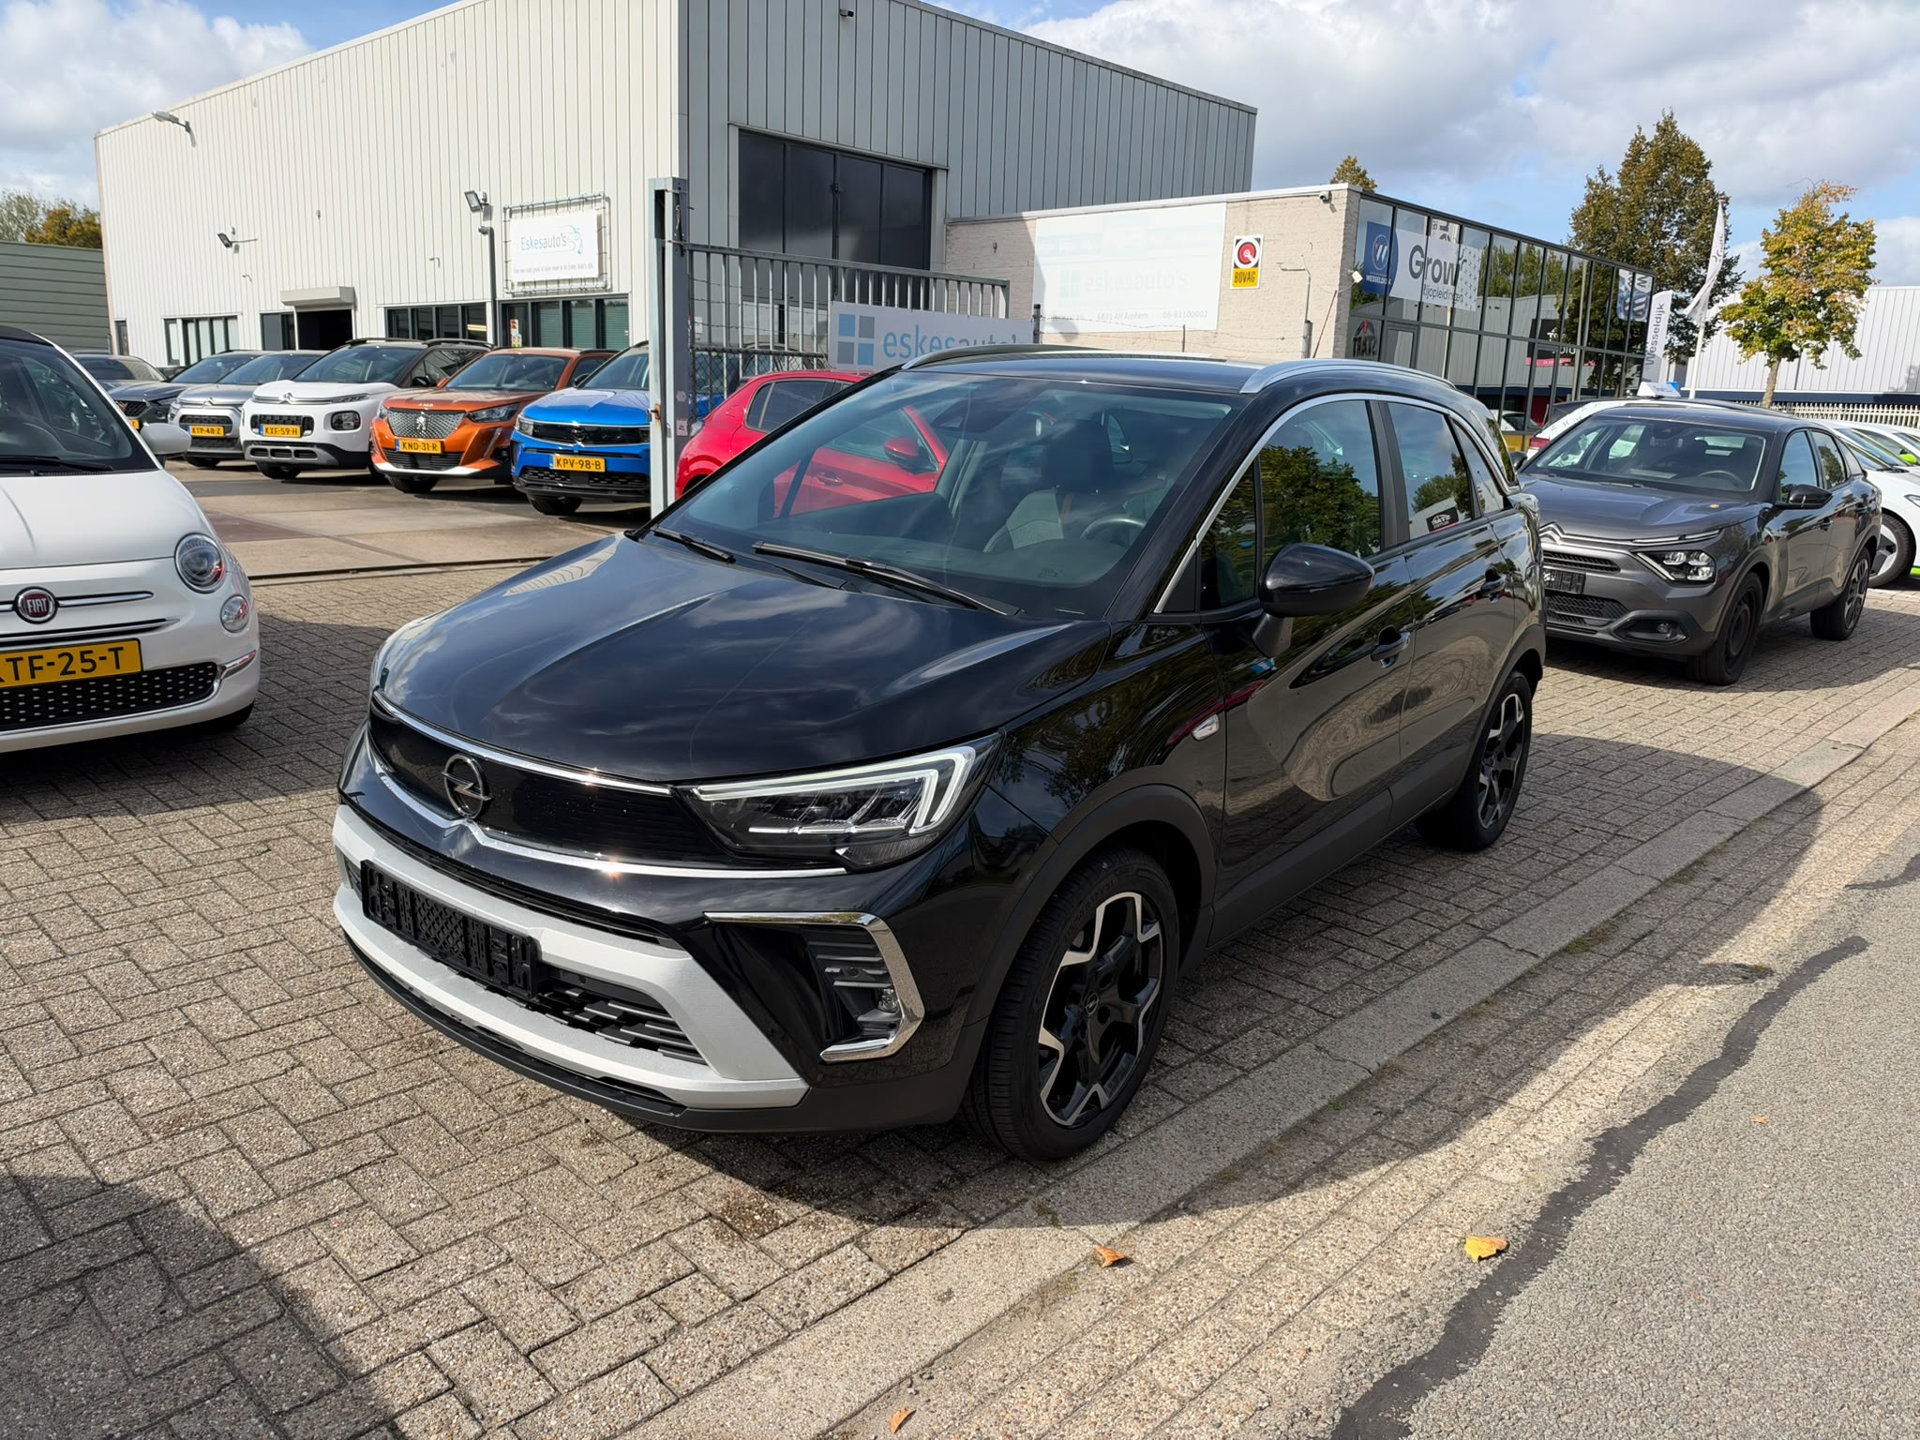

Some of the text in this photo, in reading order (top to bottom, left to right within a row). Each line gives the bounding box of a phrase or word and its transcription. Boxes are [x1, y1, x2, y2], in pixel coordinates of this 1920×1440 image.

[520, 232, 567, 251] Eskesauto's
[1408, 244, 1458, 287] Grow
[1234, 270, 1256, 284] BOVAG
[1365, 274, 1392, 285] WESSELDIK
[265, 427, 298, 435] KXF-59-H
[400, 440, 438, 451] KND-31-R
[554, 457, 602, 470] KPV-98-B
[26, 598, 47, 613] FIAT
[0, 646, 124, 682] TF-25-T
